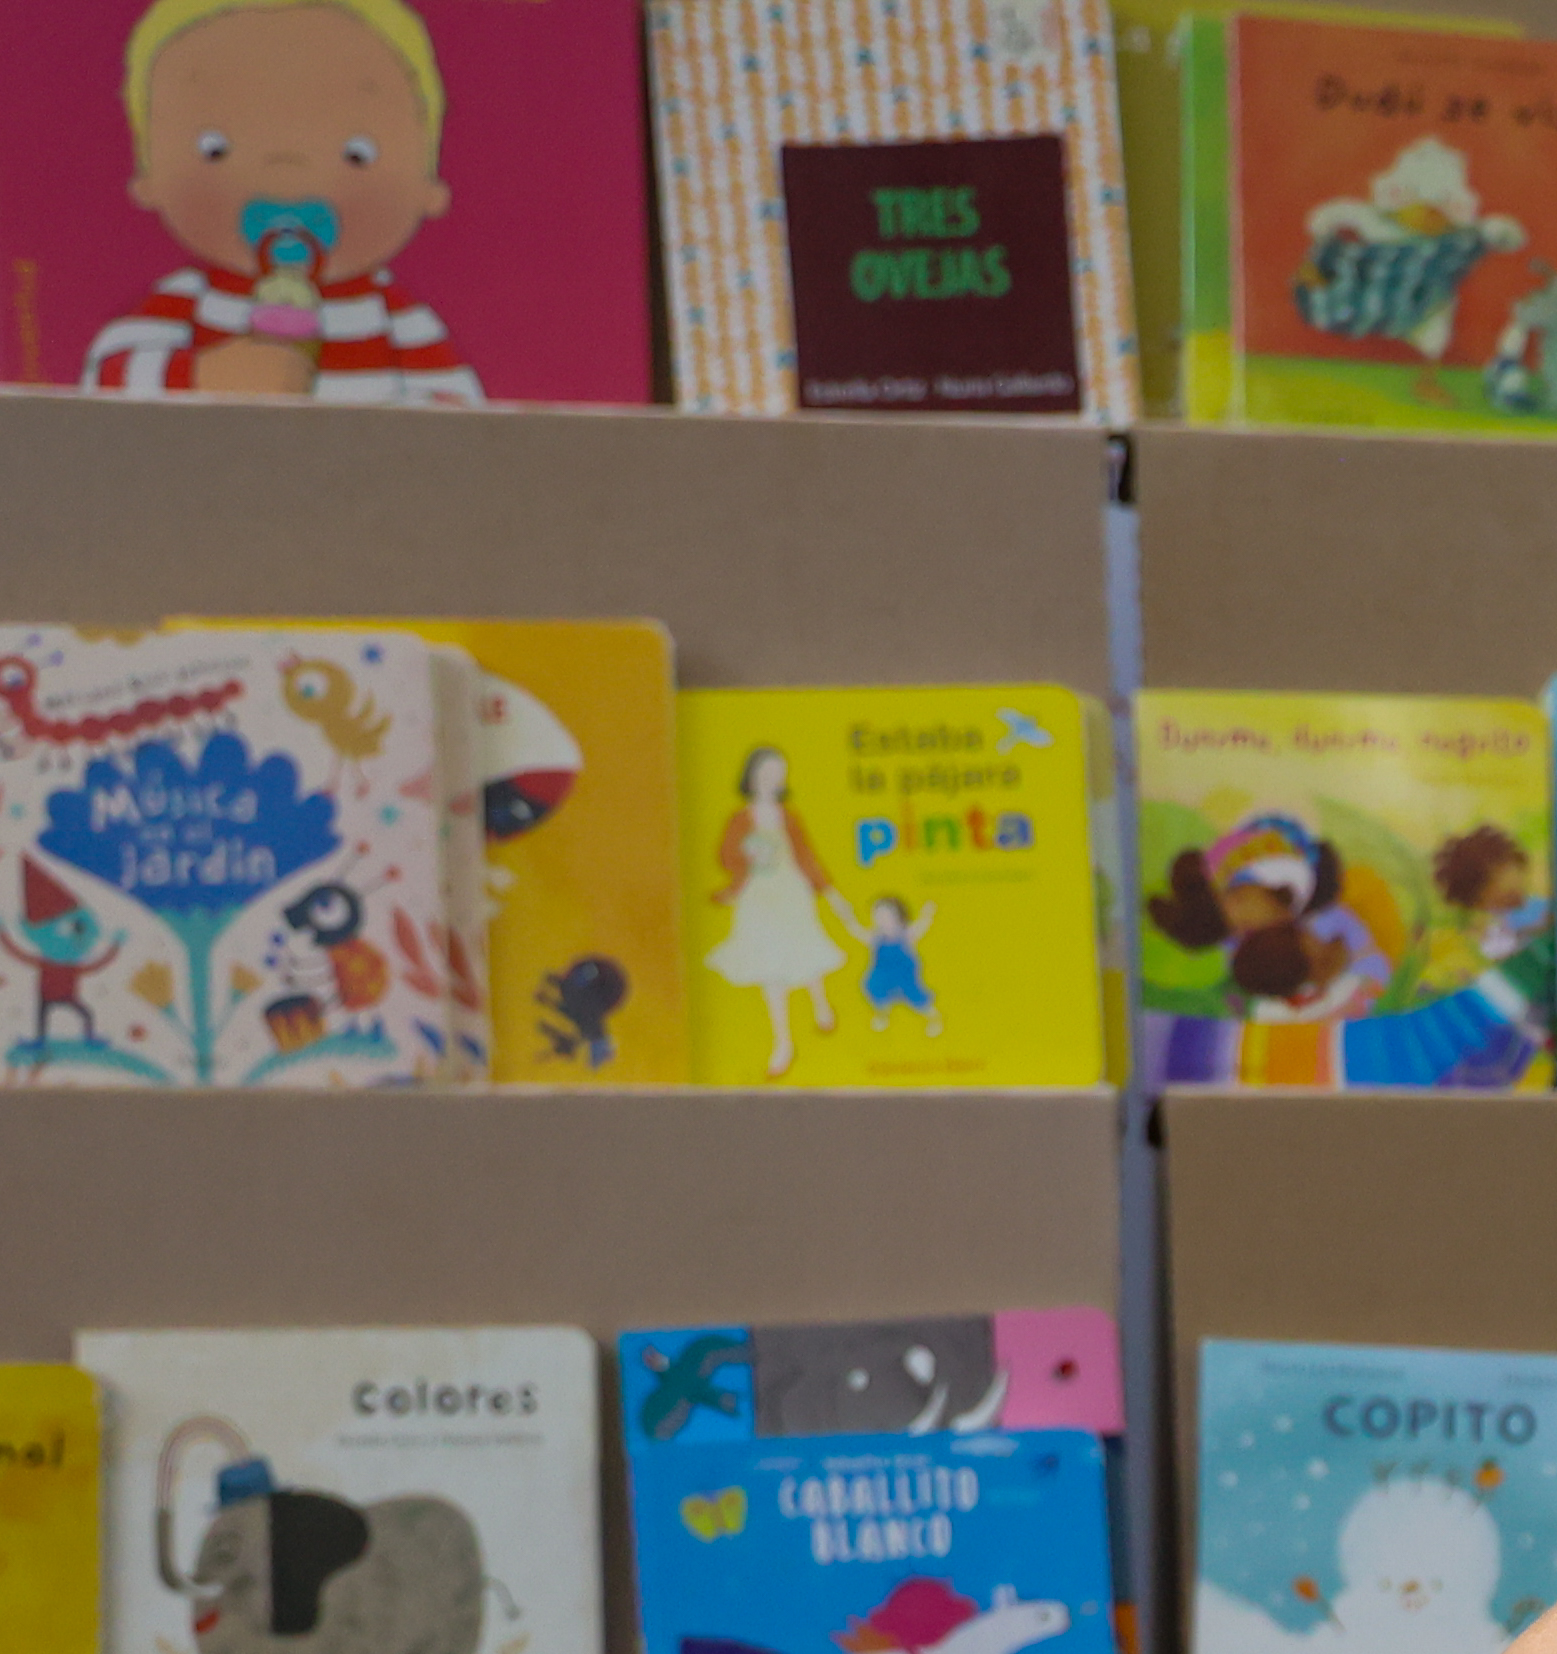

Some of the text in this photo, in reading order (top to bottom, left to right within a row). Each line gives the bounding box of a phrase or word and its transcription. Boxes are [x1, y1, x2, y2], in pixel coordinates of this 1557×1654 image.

[869, 187, 981, 239] TRES
[851, 245, 1012, 301] OVEJAS
[854, 803, 1035, 868] pinta
[1323, 1394, 1537, 1446] COPITO
[778, 1466, 979, 1518] CABALLITO
[810, 1514, 953, 1566] BLANCO
